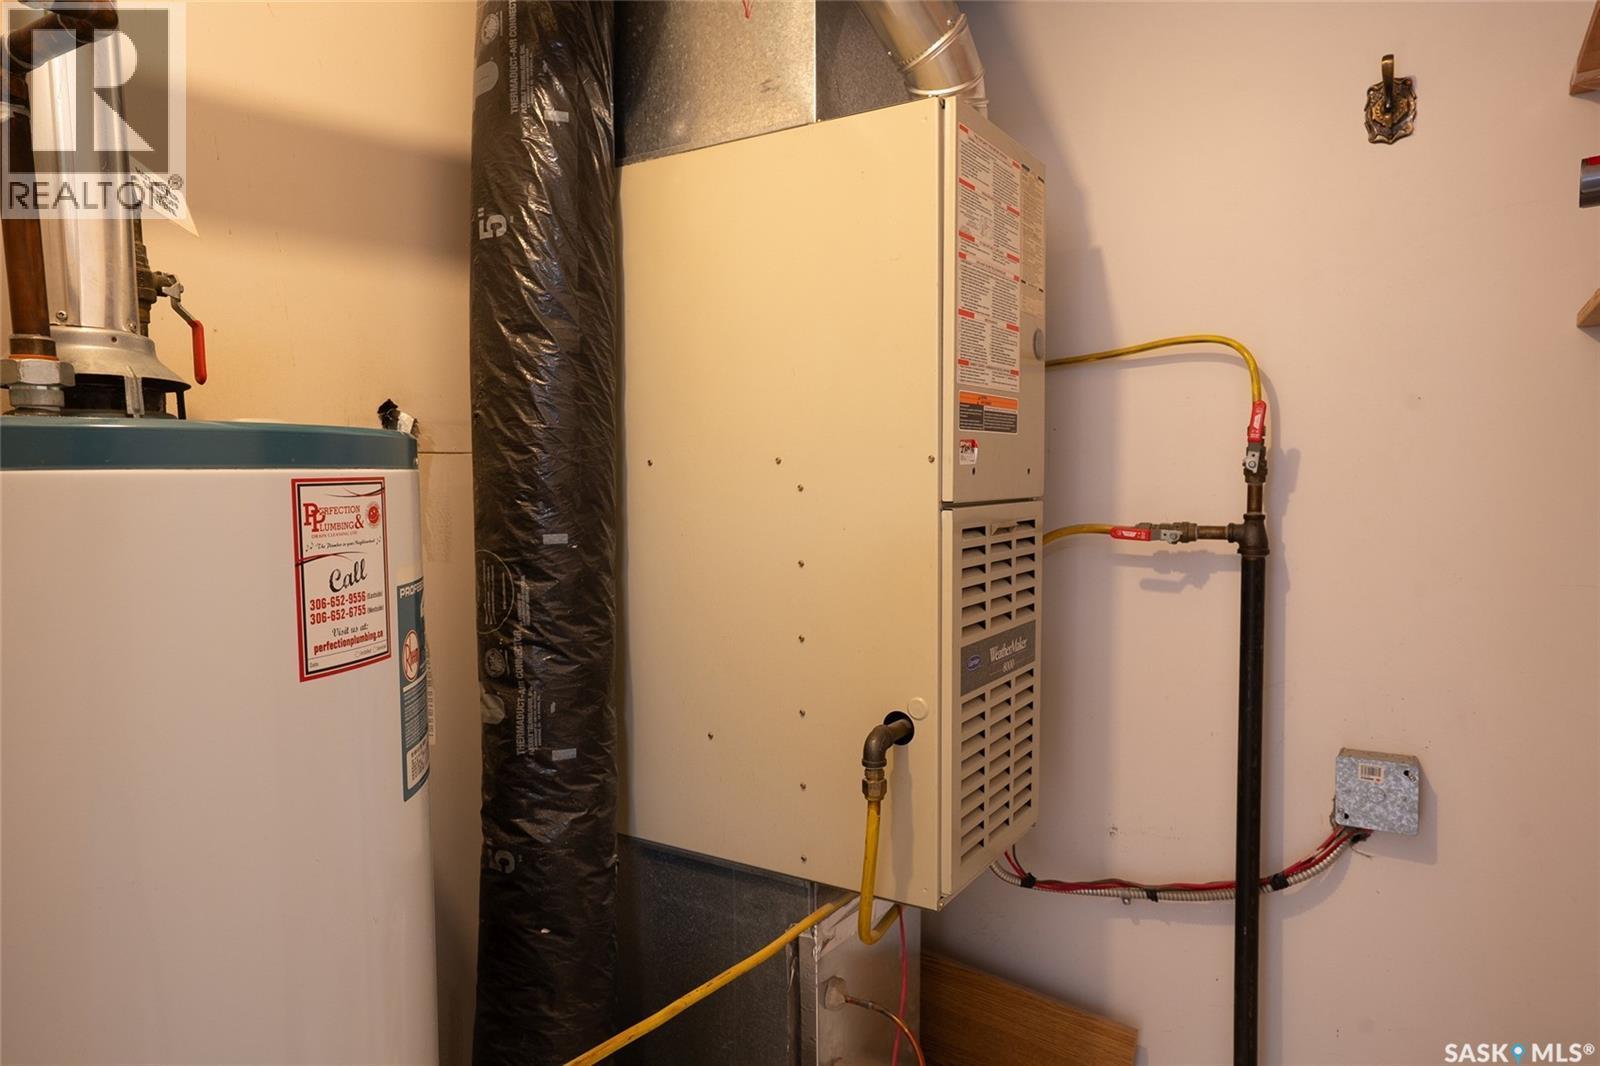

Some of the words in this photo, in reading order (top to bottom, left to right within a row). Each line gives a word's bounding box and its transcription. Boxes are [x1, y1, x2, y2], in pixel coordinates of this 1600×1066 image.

[303, 503, 361, 527] PERFECTION
[329, 558, 368, 593] Call
[309, 590, 366, 611] 306-652-9556
[310, 604, 367, 626] 306-652-6755
[313, 630, 384, 656] perfectionplumbing.ca
[331, 626, 350, 638] Visit
